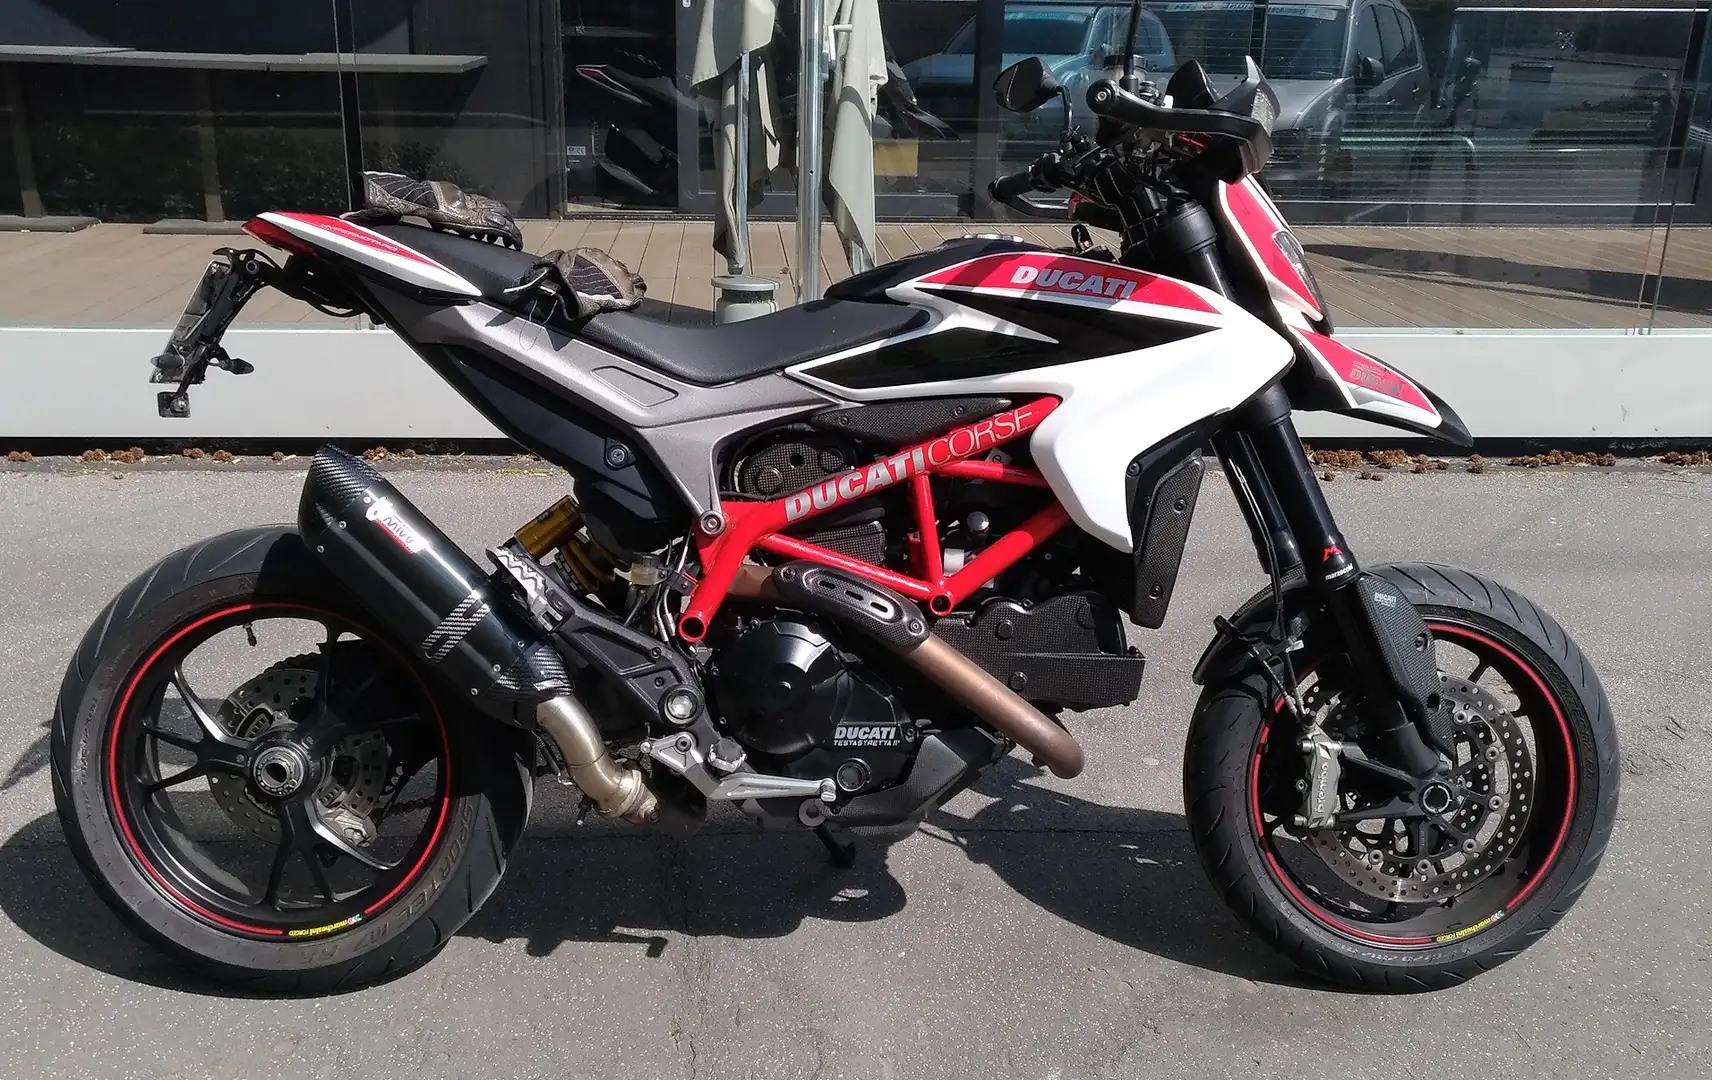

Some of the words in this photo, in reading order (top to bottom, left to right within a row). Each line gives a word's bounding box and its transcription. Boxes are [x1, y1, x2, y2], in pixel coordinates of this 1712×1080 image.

[1010, 265, 1137, 299] DUCATI
[784, 448, 925, 522] DUCATI
[927, 404, 1035, 467] CORSE
[833, 739, 892, 747] TESTASTRETTA
[834, 726, 897, 740] DUCATI
[1314, 763, 1328, 812] brembo
[309, 919, 348, 936] marchesini
[1455, 917, 1491, 938] marchesini
